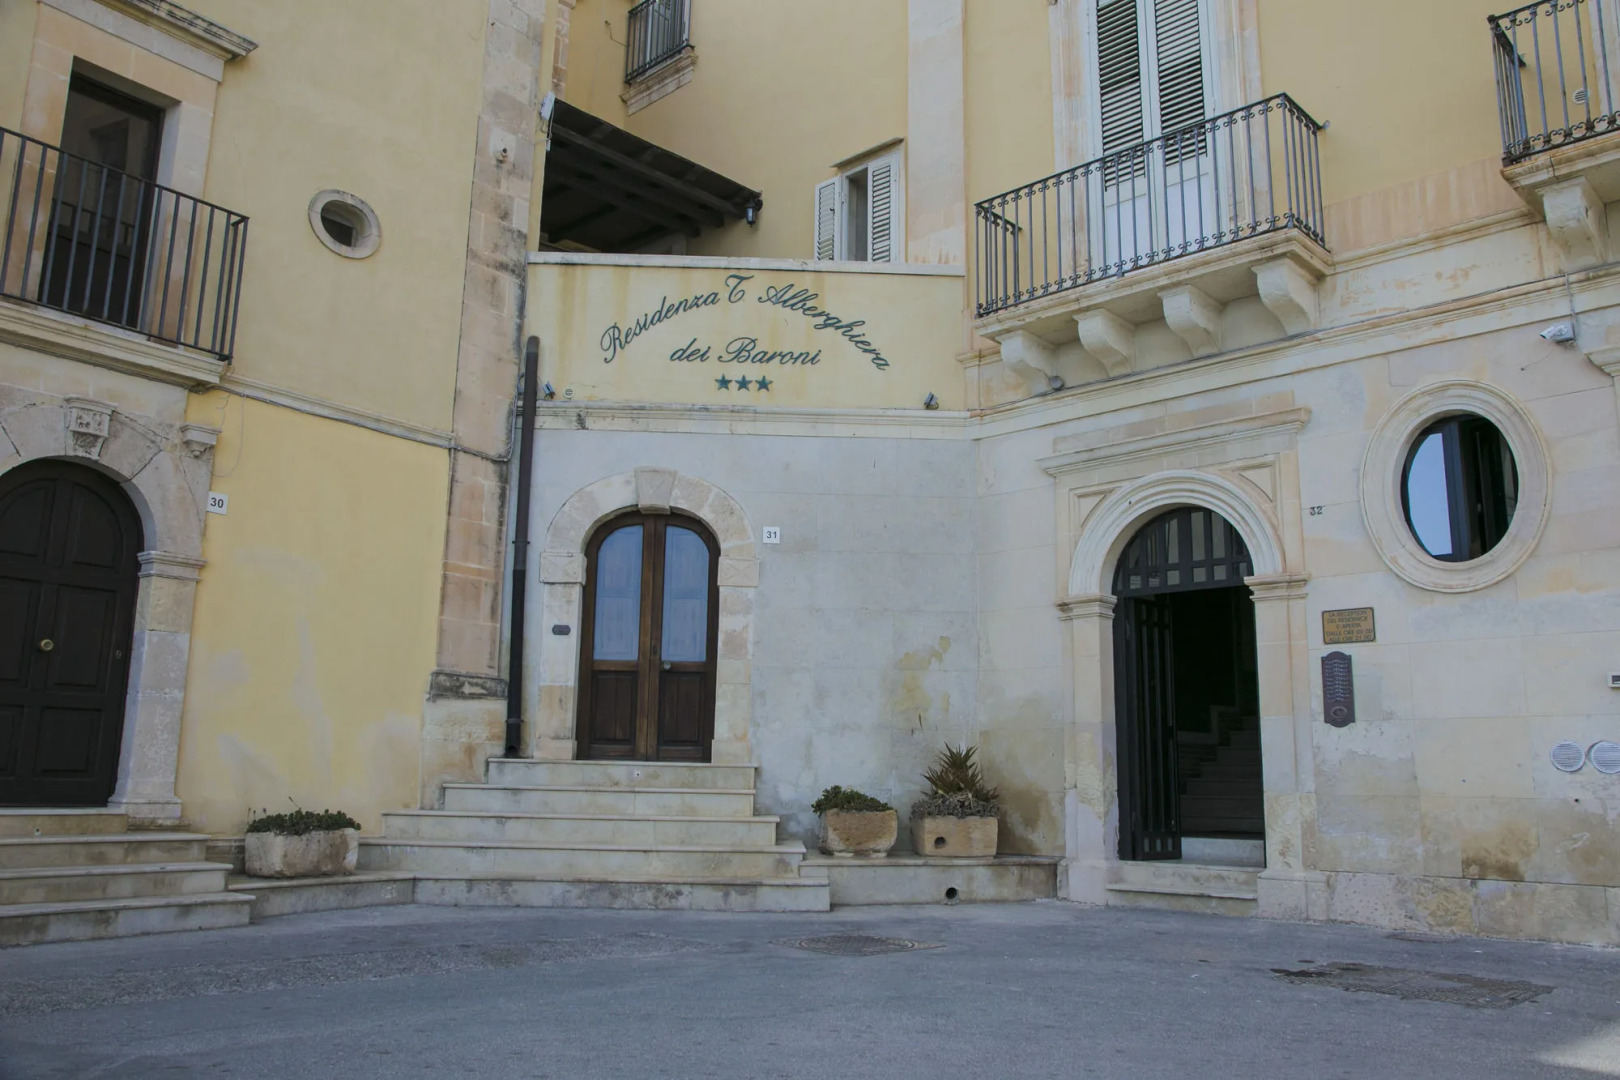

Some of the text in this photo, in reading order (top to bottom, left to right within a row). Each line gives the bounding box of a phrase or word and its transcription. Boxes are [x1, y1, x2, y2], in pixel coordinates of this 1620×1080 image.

[599, 274, 890, 371] Residenza T Alberghiera
[669, 336, 822, 365] dei Baroni
[210, 497, 224, 508] 30
[1309, 505, 1323, 516] 32
[766, 530, 777, 539] 31
